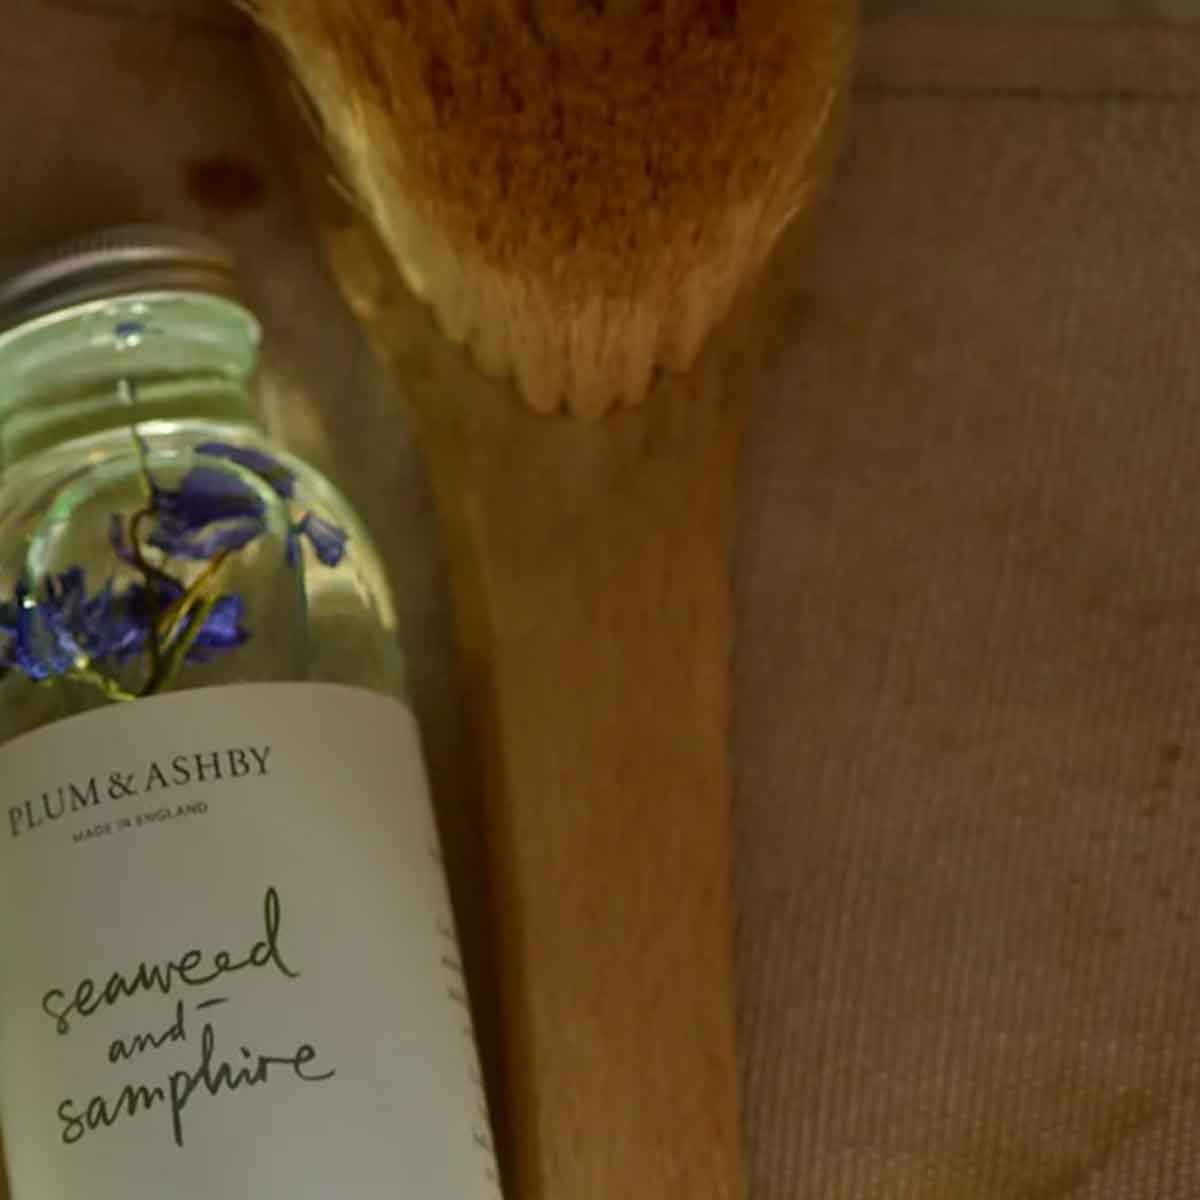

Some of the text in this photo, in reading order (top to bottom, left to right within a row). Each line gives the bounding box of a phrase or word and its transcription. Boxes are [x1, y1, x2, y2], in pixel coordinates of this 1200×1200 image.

[8, 745, 271, 837] PLUM & ASHBY
[72, 801, 208, 843] MADE IN ENGLAND
[42, 885, 300, 1035] seaweed
[108, 1000, 186, 1063] and
[57, 1023, 335, 1146] samphire
